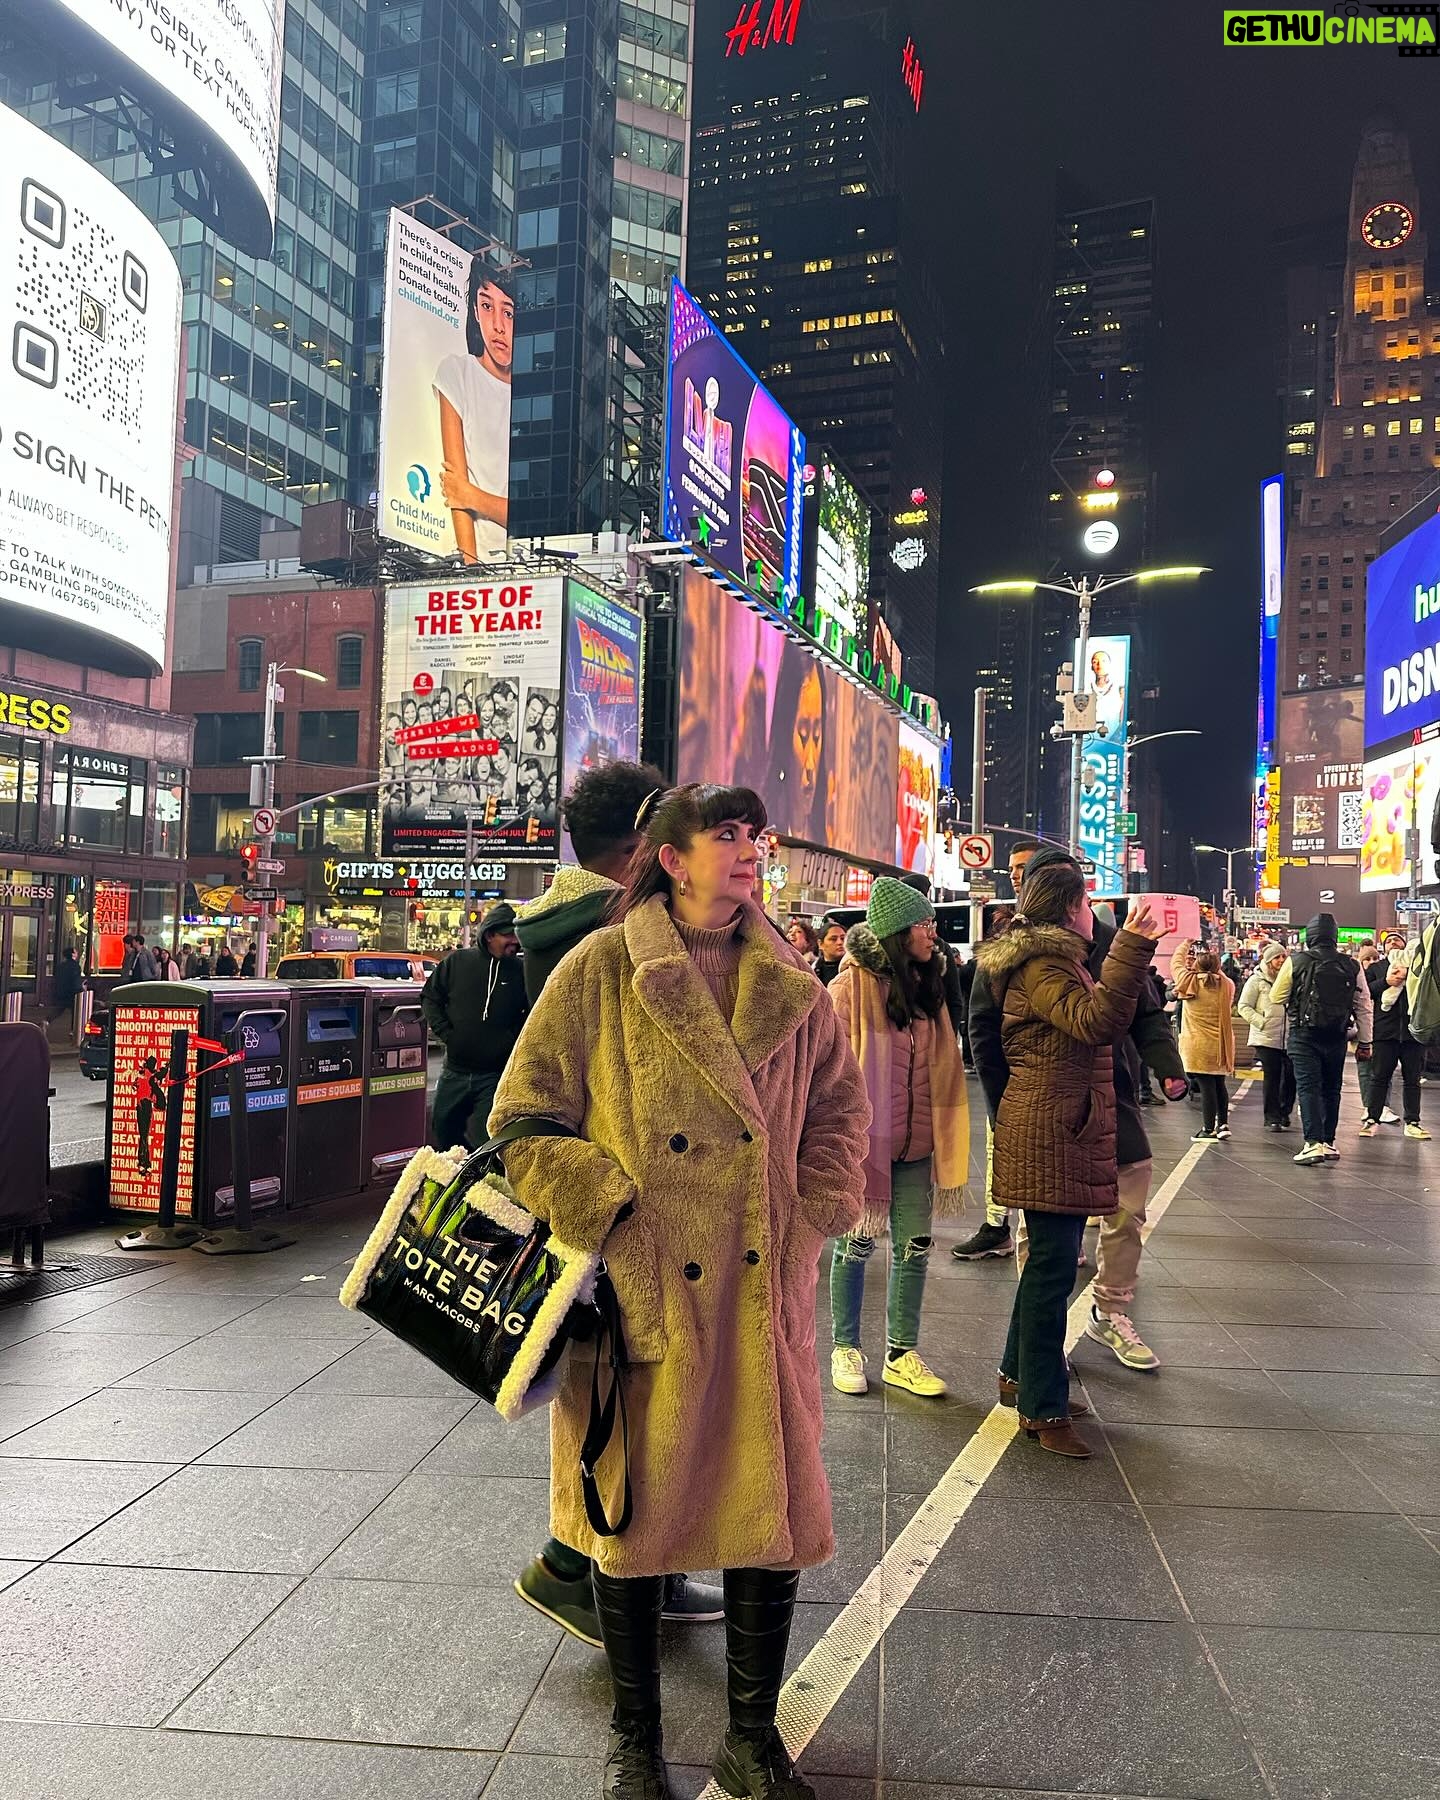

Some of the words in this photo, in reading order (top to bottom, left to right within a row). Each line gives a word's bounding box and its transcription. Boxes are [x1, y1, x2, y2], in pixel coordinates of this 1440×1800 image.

[725, 0, 801, 57] H&M
[151, 25, 176, 57] OR
[182, 50, 223, 98] TEXT
[902, 36, 924, 113] H&M
[399, 222, 432, 250] There's
[432, 245, 439, 255] a
[440, 250, 464, 269] crisis
[400, 238, 409, 252] in
[410, 246, 454, 278] children's
[400, 256, 431, 281] mental
[433, 273, 463, 299] health.
[398, 270, 432, 296] Donate
[433, 289, 460, 312] today.
[398, 287, 460, 329] childmind.org
[12, 430, 87, 485] SIGN
[95, 466, 135, 512] THE
[8, 489, 54, 521] ALWAYS
[56, 506, 75, 527] BET
[390, 498, 419, 519] Child
[421, 509, 446, 529] Mind
[396, 515, 440, 541] Institute
[11, 543, 30, 558] TO
[34, 550, 66, 571] TALK
[70, 564, 99, 584] WITH
[10, 559, 81, 592] GAMBLING
[0, 570, 47, 594] OPENY
[51, 585, 100, 614] (467369)
[428, 588, 493, 612] BEST
[498, 585, 534, 607] OF
[414, 613, 463, 636] THE
[469, 610, 542, 634] YEAR!
[612, 610, 631, 629] CHANGE
[575, 617, 635, 673] BACK
[581, 660, 594, 679] TO
[1382, 641, 1440, 716] DISN
[593, 664, 634, 695] FUTURE
[395, 723, 450, 740] MERRILY
[459, 717, 475, 727] WE
[411, 747, 442, 756] ROLL
[453, 743, 493, 753] ALONG
[393, 829, 423, 837] LIMITED
[509, 829, 526, 837] JULY
[336, 862, 394, 879] GIFTS
[409, 863, 506, 880] LUGGAGE
[0, 884, 55, 900] EXPRESS
[95, 887, 127, 899] SALE
[403, 878, 409, 888] I
[417, 879, 435, 889] NY
[421, 889, 450, 897] SONY
[95, 899, 126, 911] SALE
[1319, 889, 1336, 904] 2
[95, 911, 126, 923] SALE
[115, 1009, 134, 1019] JAM
[139, 1009, 160, 1020] BAD
[164, 1010, 199, 1021] MONEY
[115, 1021, 153, 1032] SMOOTH
[155, 1022, 198, 1033] CRIMINAL
[115, 1034, 132, 1045] BILLIE
[133, 1035, 149, 1046] JEAN
[115, 1047, 136, 1058] BLAME
[139, 1047, 146, 1058] IT
[159, 1048, 171, 1059] THE
[114, 1059, 134, 1070] CAN
[114, 1072, 129, 1083] THEY
[371, 1081, 396, 1092] TIMES
[396, 1076, 425, 1088] SQUARE
[247, 1093, 286, 1108] SQUARE
[299, 1088, 327, 1100] TIMES
[328, 1083, 361, 1095] SQUARE
[112, 1096, 132, 1107] MAN
[112, 1109, 128, 1119] DON'T
[112, 1121, 126, 1131] KEEP
[126, 1121, 136, 1131] THE
[111, 1133, 140, 1145] BEAT
[110, 1182, 143, 1194] THRILLER
[147, 1185, 160, 1196] I'LL
[129, 1196, 137, 1207] BE
[440, 1234, 498, 1284] THE
[392, 1236, 457, 1294] TOTE
[459, 1284, 527, 1335] BAG
[403, 1277, 434, 1304] MARC
[436, 1300, 481, 1334] JACOBS
